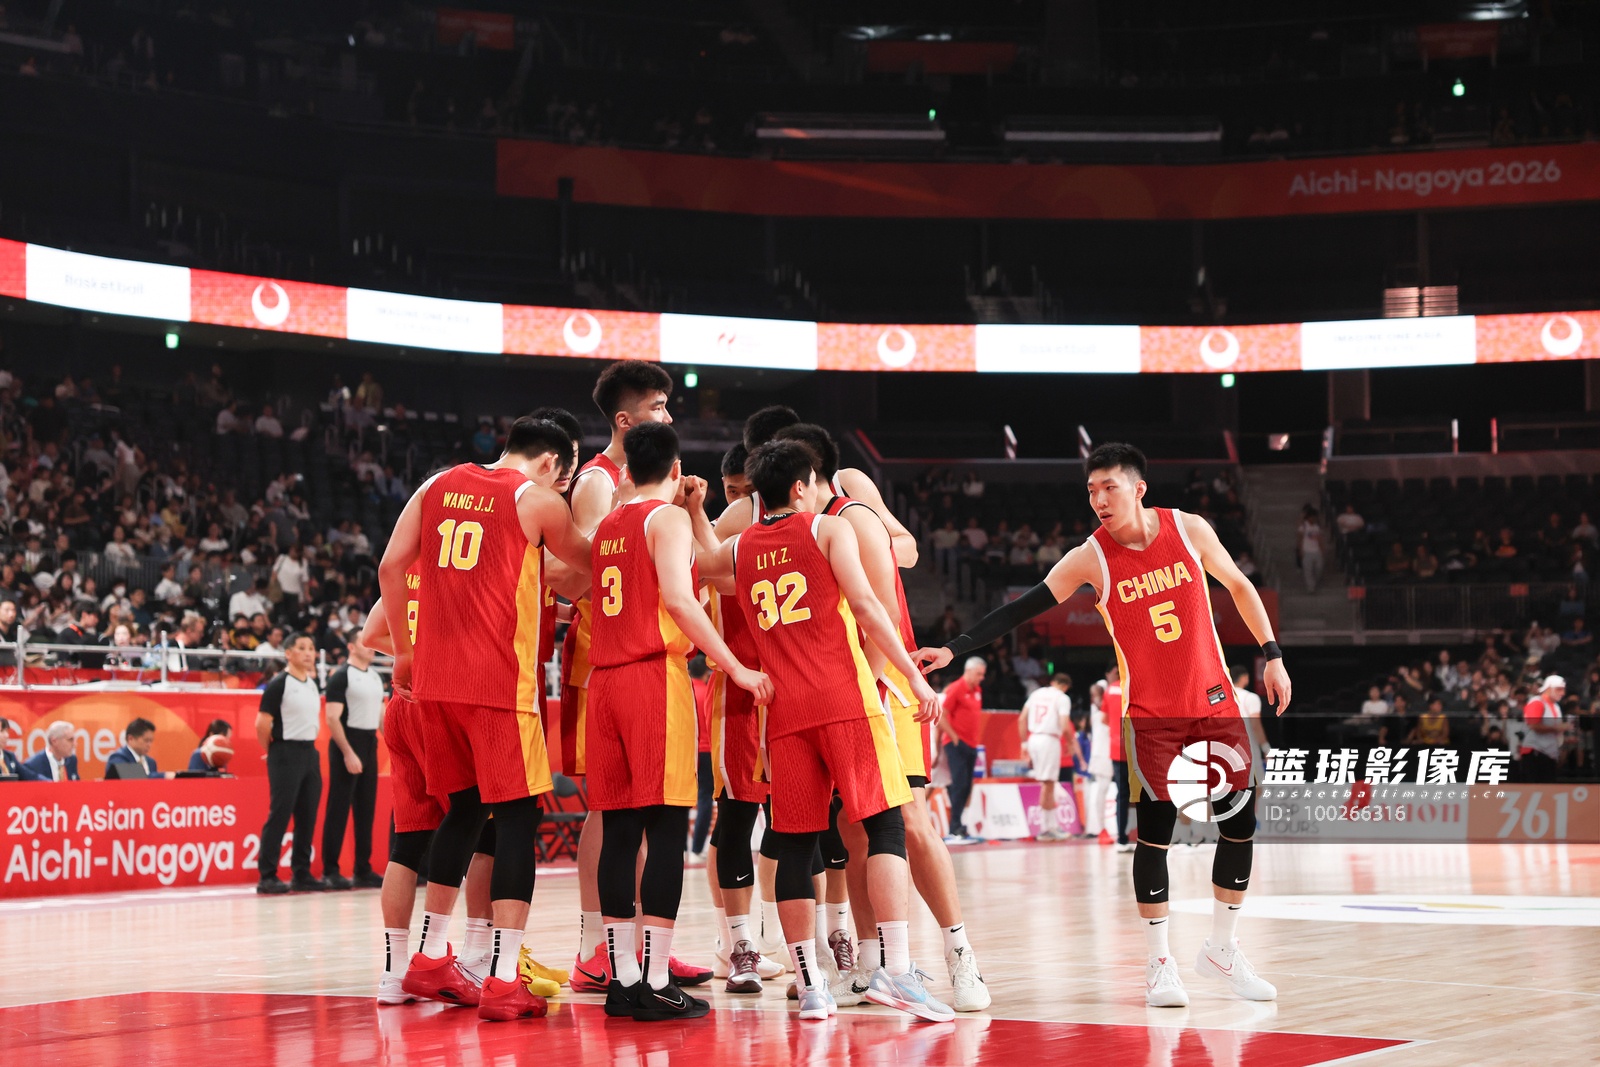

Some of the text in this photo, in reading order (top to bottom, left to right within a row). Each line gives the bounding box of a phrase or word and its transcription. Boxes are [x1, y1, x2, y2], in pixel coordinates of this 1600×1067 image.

[1288, 160, 1562, 197] Aichi-Nagoya 2026
[443, 491, 495, 512] WANG J.J.
[437, 518, 484, 570] 10
[757, 547, 792, 570] LI Y.Z.
[602, 566, 623, 617] 3
[750, 571, 811, 631] 32
[1116, 561, 1193, 604] CHINA
[1148, 600, 1182, 643] 5
[6, 800, 236, 835] 20th Asian Games
[4, 831, 316, 886] Aichi-Nagoya 22
